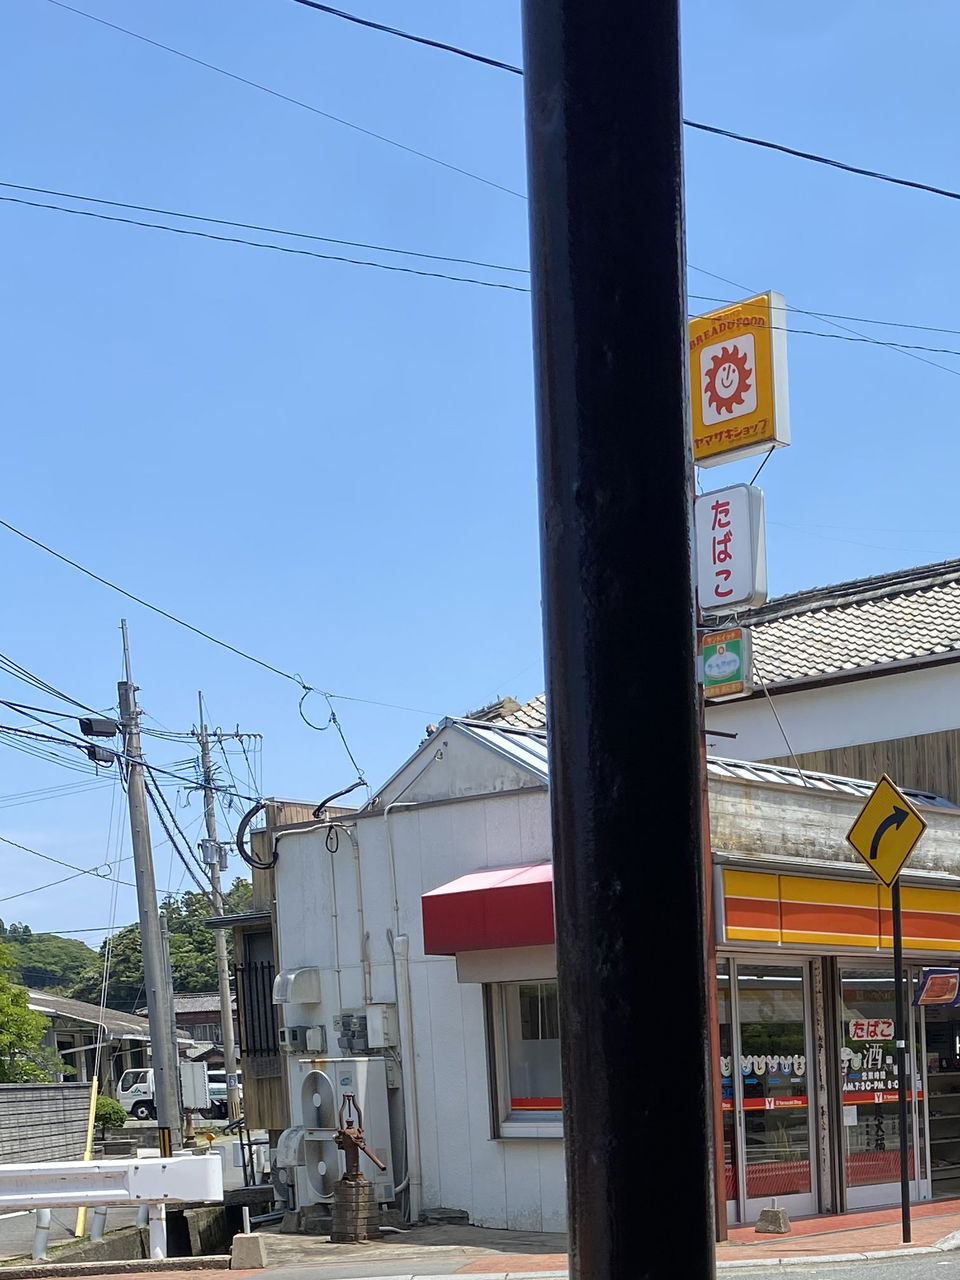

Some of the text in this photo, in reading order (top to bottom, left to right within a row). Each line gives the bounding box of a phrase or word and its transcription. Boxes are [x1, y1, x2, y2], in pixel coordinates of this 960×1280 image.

[689, 321, 727, 351] BREAD
[694, 418, 768, 449] ヤマザキショップ
[711, 500, 734, 598] たばこ
[852, 1020, 893, 1039] たばこ
[863, 1043, 884, 1069] 酒
